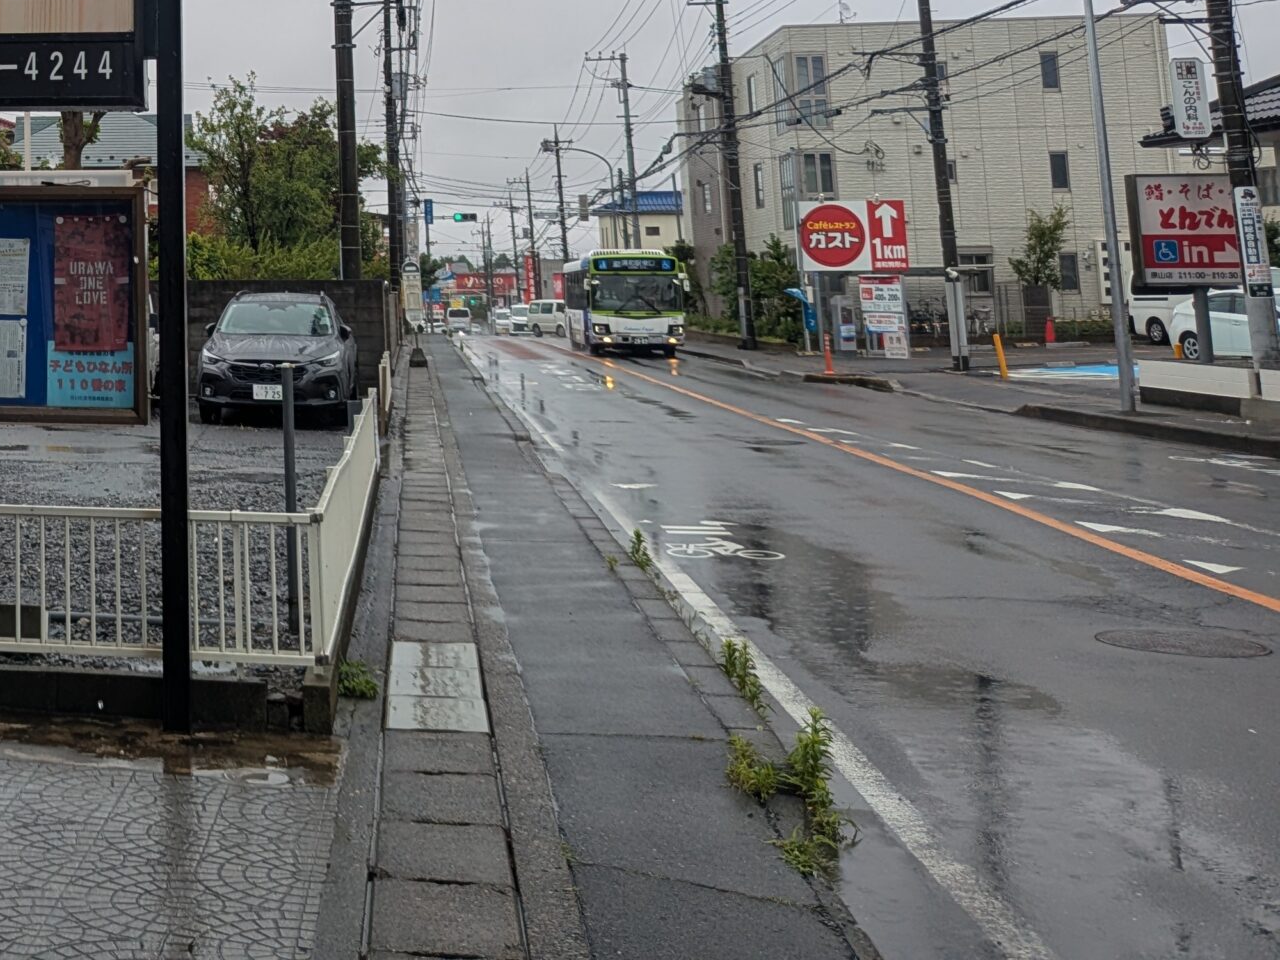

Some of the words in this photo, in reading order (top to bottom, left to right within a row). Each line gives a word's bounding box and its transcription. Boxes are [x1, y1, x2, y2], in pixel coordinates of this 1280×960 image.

[809, 231, 860, 249] ガスト
[1182, 240, 1210, 264] in
[69, 260, 114, 275] URAWA
[79, 276, 104, 290] ONE
[75, 291, 108, 305] LOVE
[49, 360, 133, 376] 子どもひなん所
